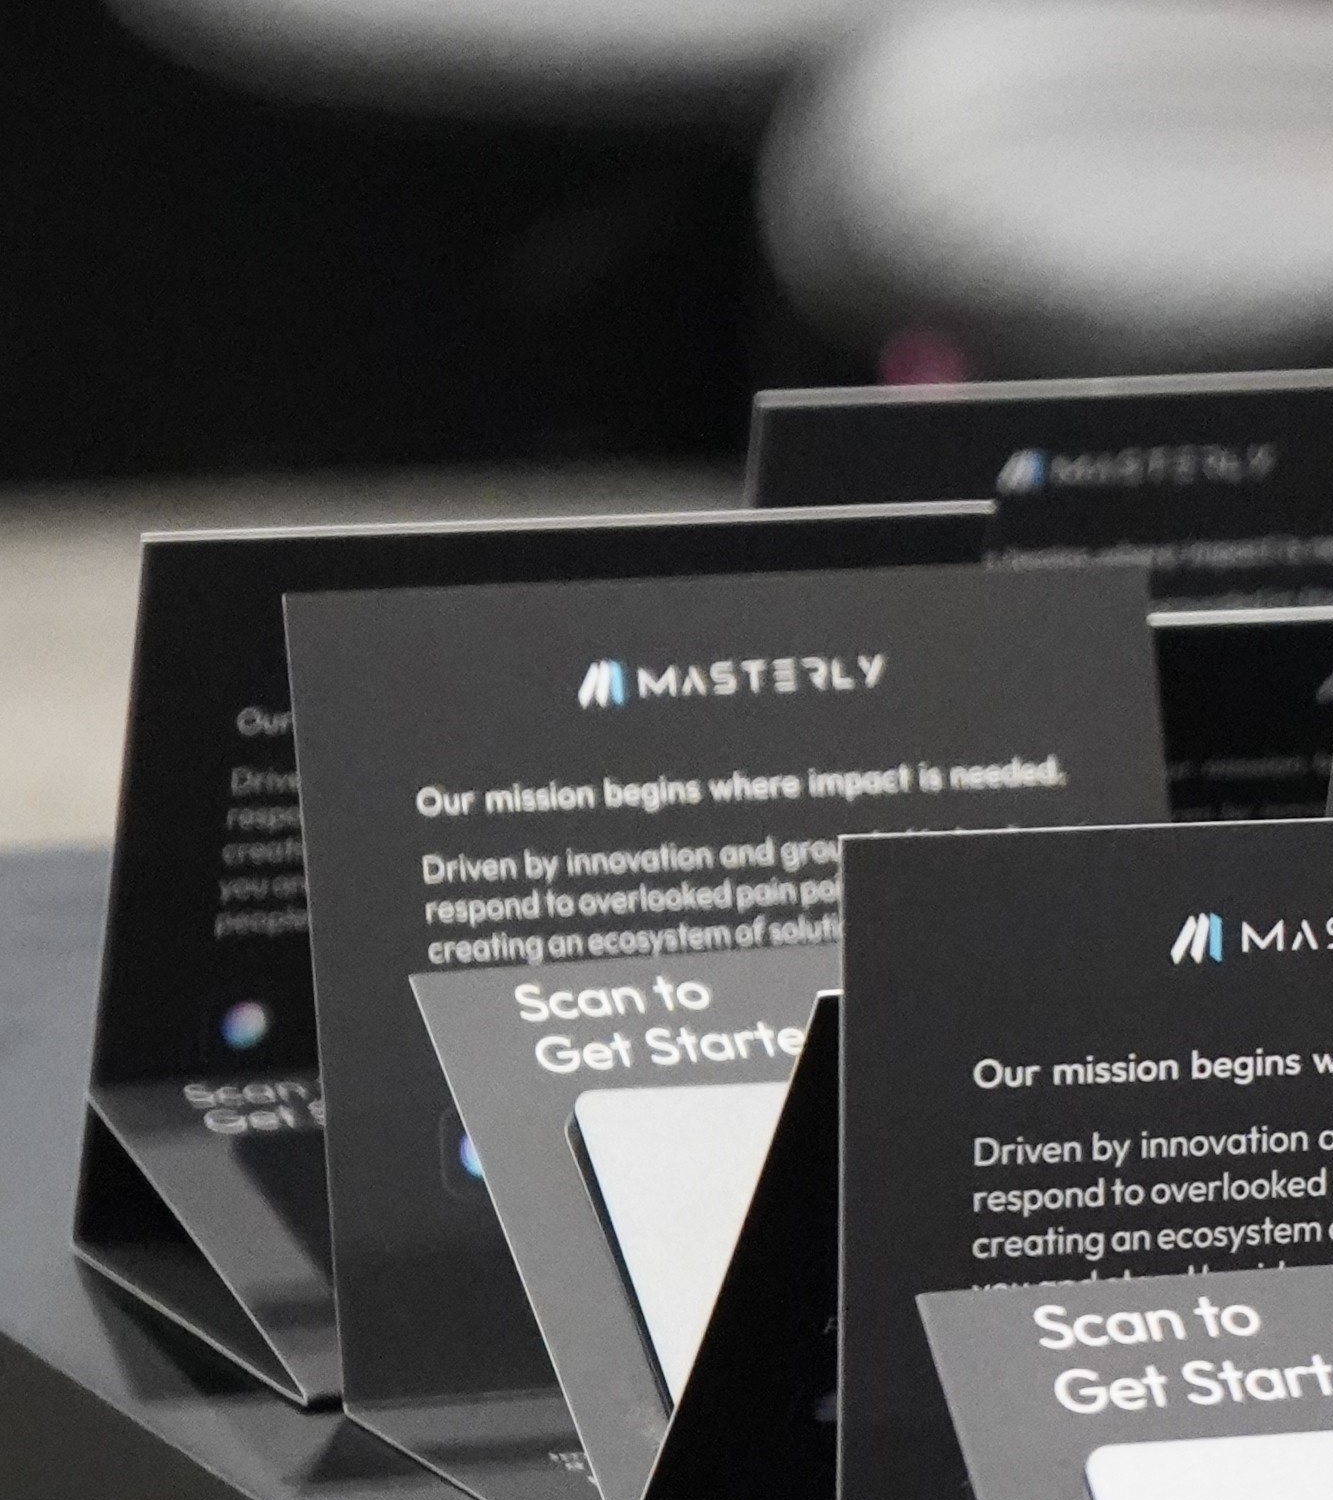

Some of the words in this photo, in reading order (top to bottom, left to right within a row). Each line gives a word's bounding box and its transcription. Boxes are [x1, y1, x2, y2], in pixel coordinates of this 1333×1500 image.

[638, 655, 884, 697] MASTERLY
[416, 787, 475, 817] Our
[485, 781, 596, 813] mission
[604, 776, 702, 813] begins
[709, 771, 802, 801] where
[809, 764, 912, 801] impact
[515, 984, 646, 1022] Scan
[653, 976, 711, 1011] to
[535, 1033, 631, 1073] Get
[645, 1022, 807, 1065] Starte
[973, 1059, 1040, 1089] Our
[1053, 1056, 1179, 1085] mission
[1192, 1050, 1301, 1085] begins
[974, 1137, 1082, 1166] Driven
[1093, 1132, 1131, 1167] by
[1142, 1126, 1308, 1158] innovation
[974, 1178, 1105, 1217] respond
[1111, 1179, 1145, 1205] to
[1151, 1167, 1326, 1204] overlooked
[973, 1227, 1105, 1261] creating
[1111, 1230, 1151, 1252] an
[1157, 1217, 1322, 1253] ecosystem
[1034, 1305, 1186, 1349] Scan
[1194, 1297, 1261, 1337] to
[1054, 1365, 1167, 1414] Get
